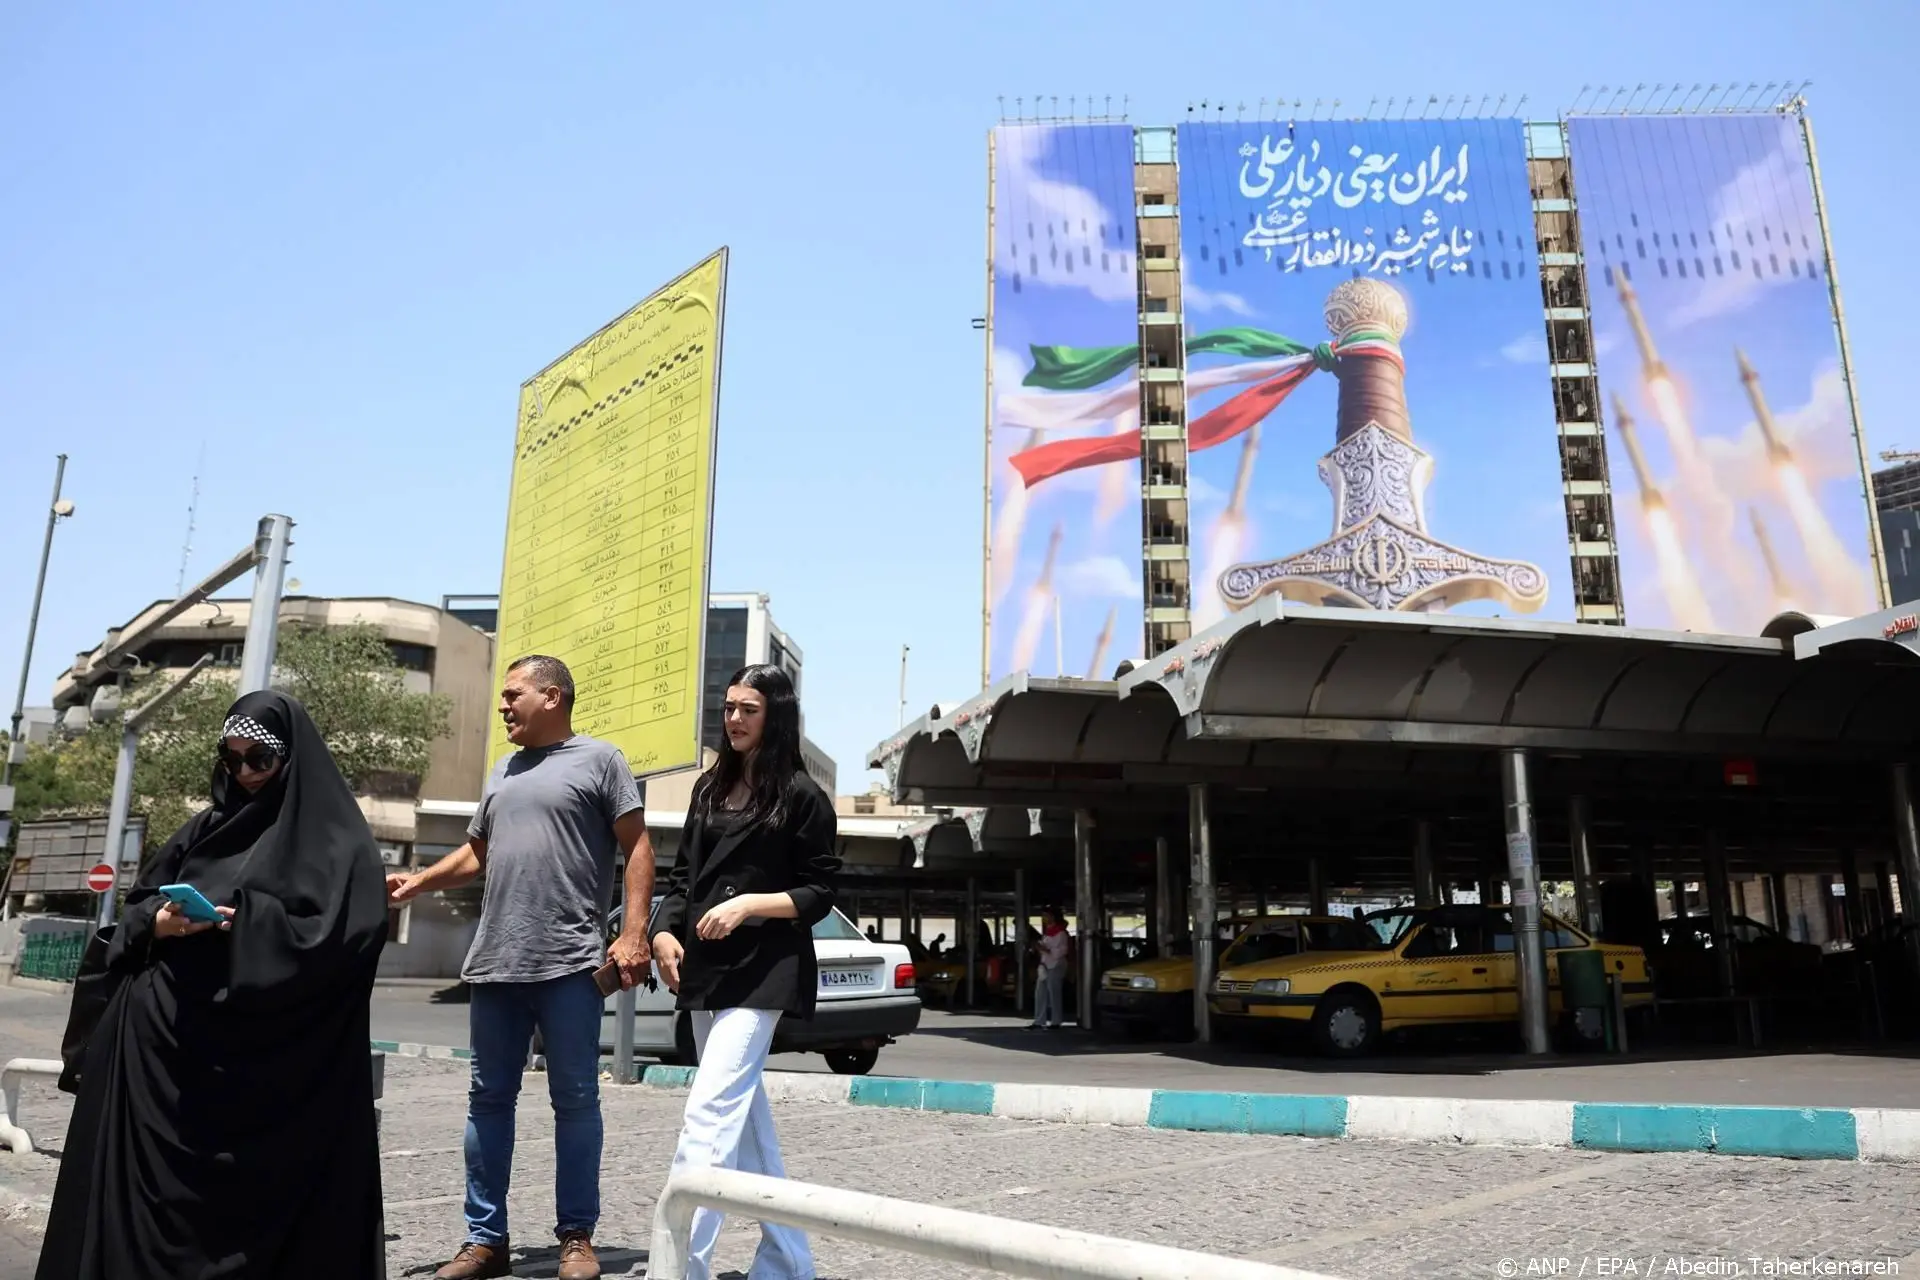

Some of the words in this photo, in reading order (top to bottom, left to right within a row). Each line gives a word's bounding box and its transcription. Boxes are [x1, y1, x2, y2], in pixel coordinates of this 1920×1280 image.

[1239, 134, 1295, 198] علی
[1333, 145, 1398, 208] یعنی
[1389, 144, 1468, 205] ایران
[656, 382, 671, 394] خط
[671, 365, 699, 387] شماره
